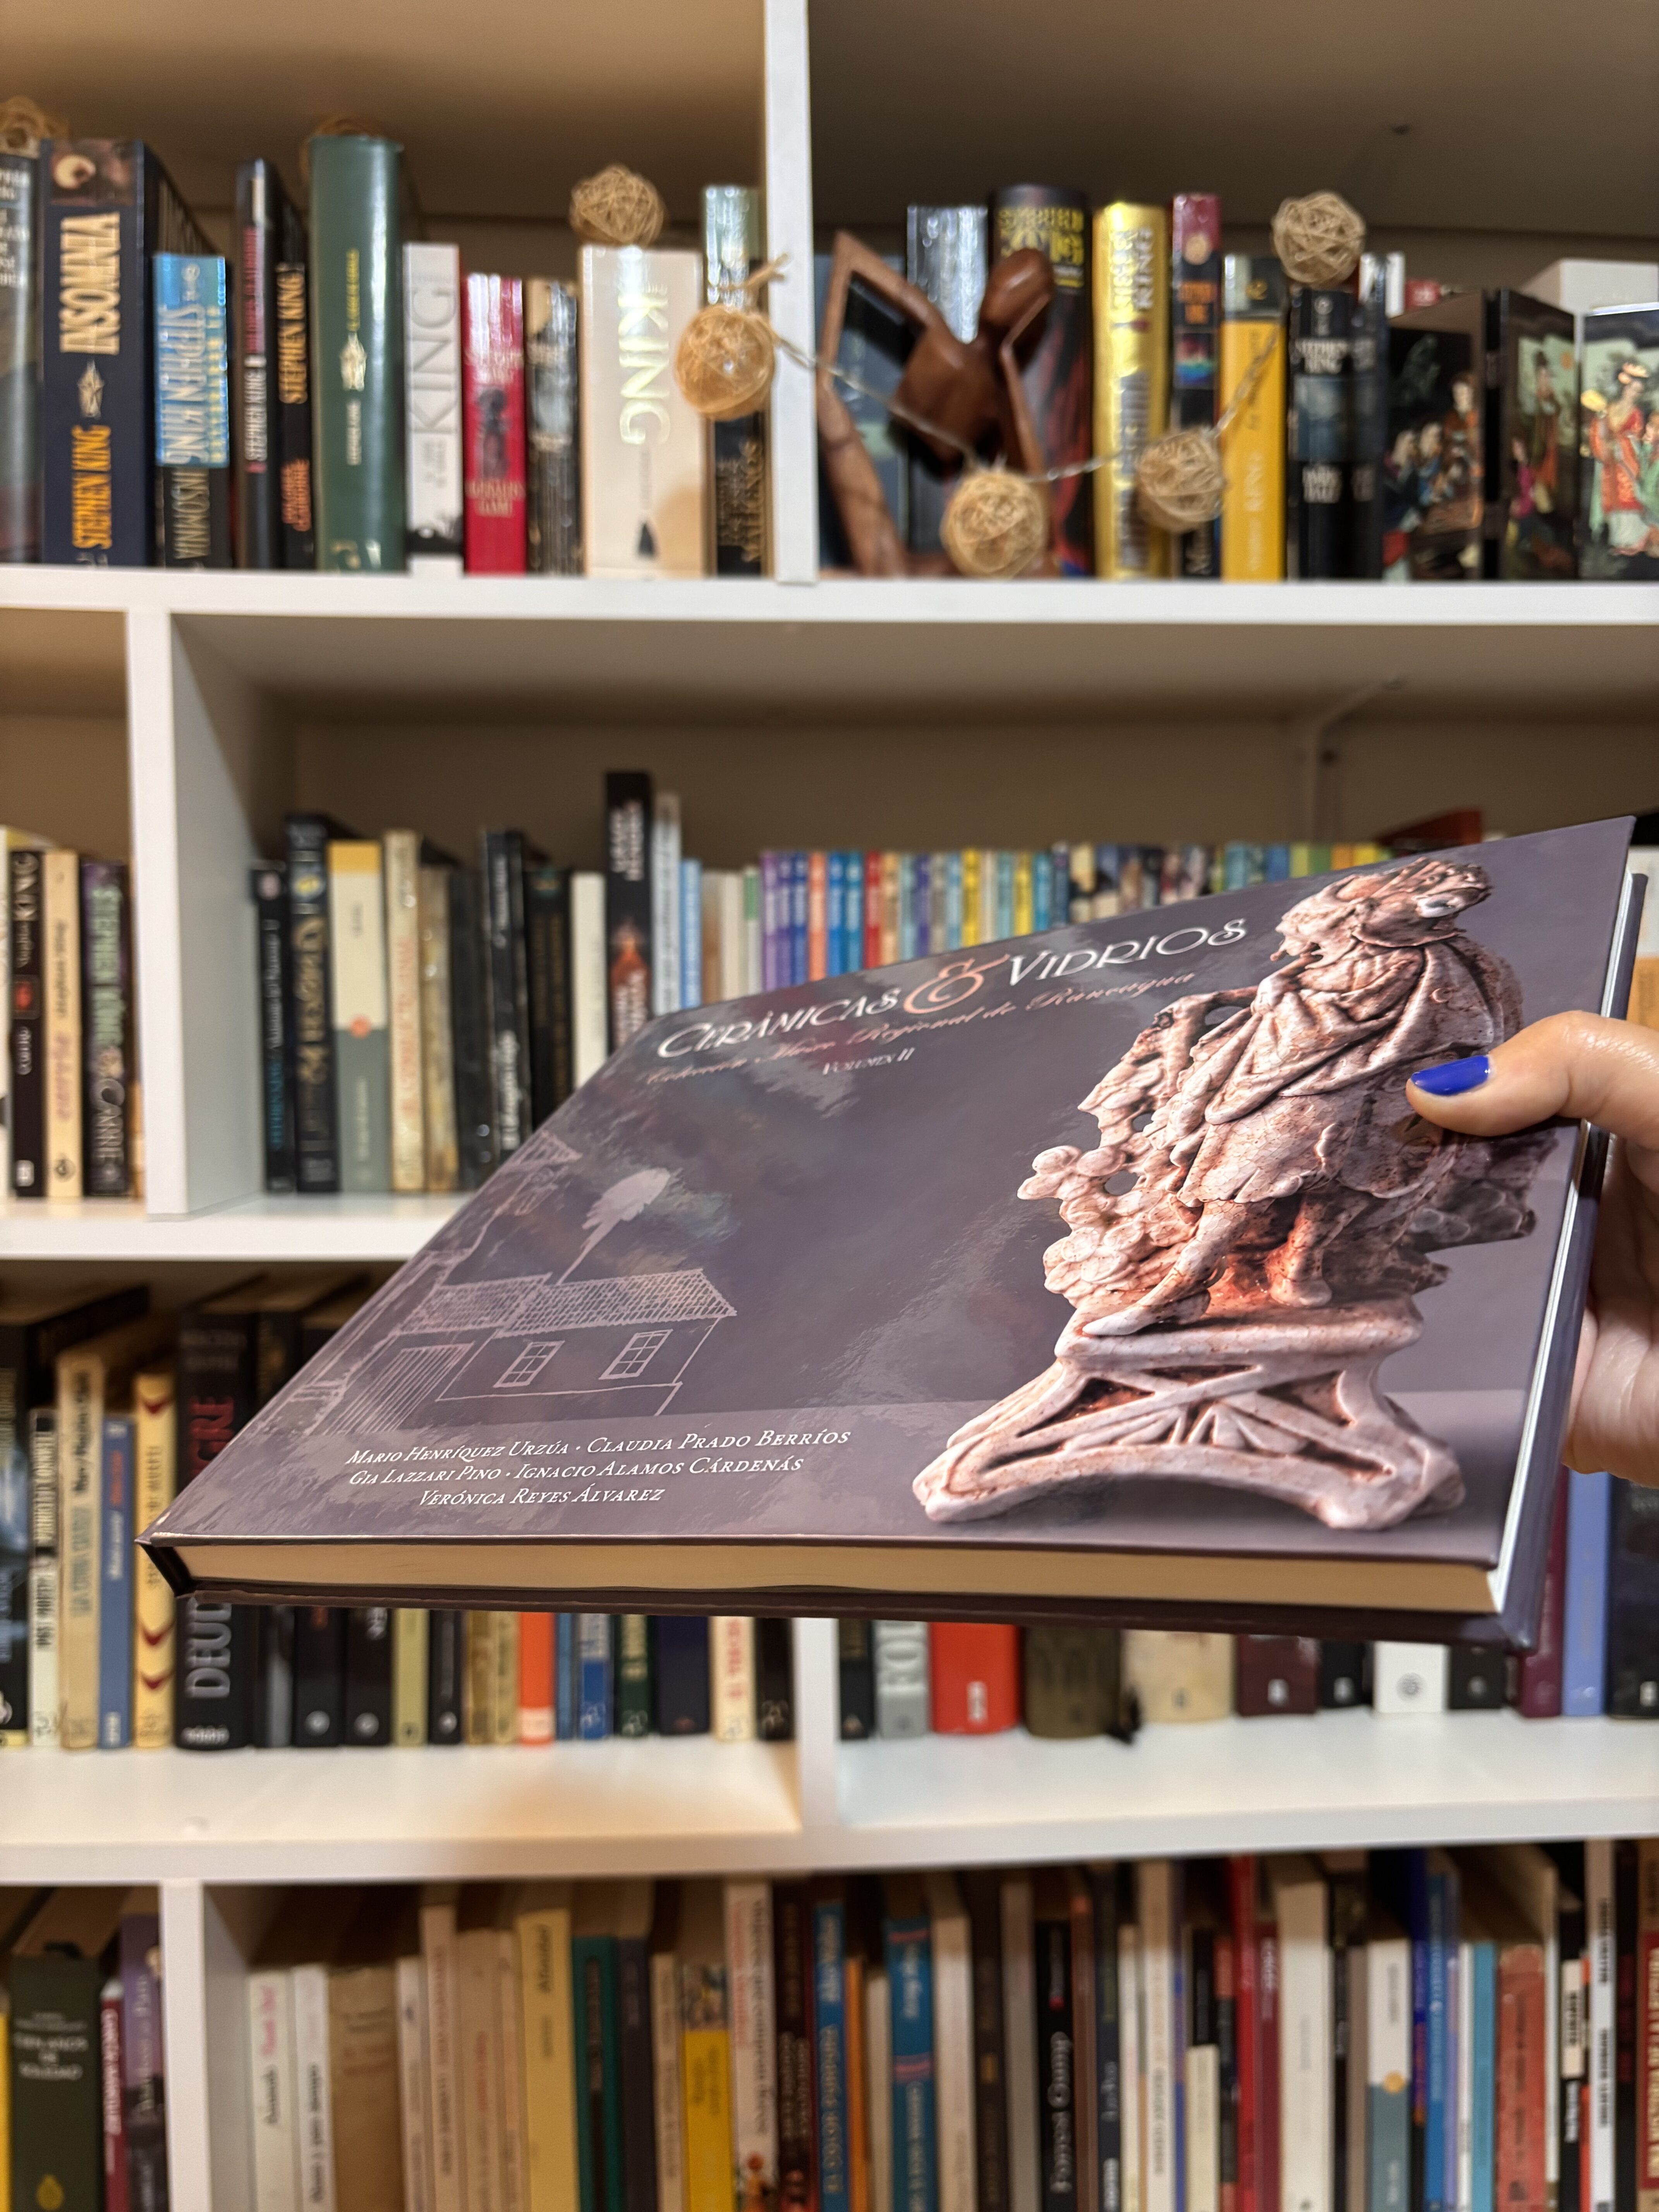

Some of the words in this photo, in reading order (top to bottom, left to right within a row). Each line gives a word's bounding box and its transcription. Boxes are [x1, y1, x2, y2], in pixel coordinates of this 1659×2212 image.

[156, 304, 209, 400] STEPHEN
[410, 285, 457, 434] KING
[618, 290, 671, 445] KING
[70, 424, 112, 471] KING
[156, 400, 211, 465] KING
[70, 472, 112, 550] STEPHEN
[170, 469, 210, 559] INSOMNIA
[903, 954, 1011, 1015] &
[344, 1449, 402, 1465] MARIO
[587, 1437, 672, 1453] CLAUDIA
[677, 1433, 751, 1449] PRADO
[349, 1470, 378, 1485] GIA
[380, 1469, 456, 1484] LAZZARI
[455, 1465, 502, 1481] PINO
[513, 1463, 597, 1479] IGNACIO
[596, 1460, 685, 1476] ALAMOS
[419, 1490, 505, 1506] VERÓNICA
[509, 1488, 571, 1503] REYES
